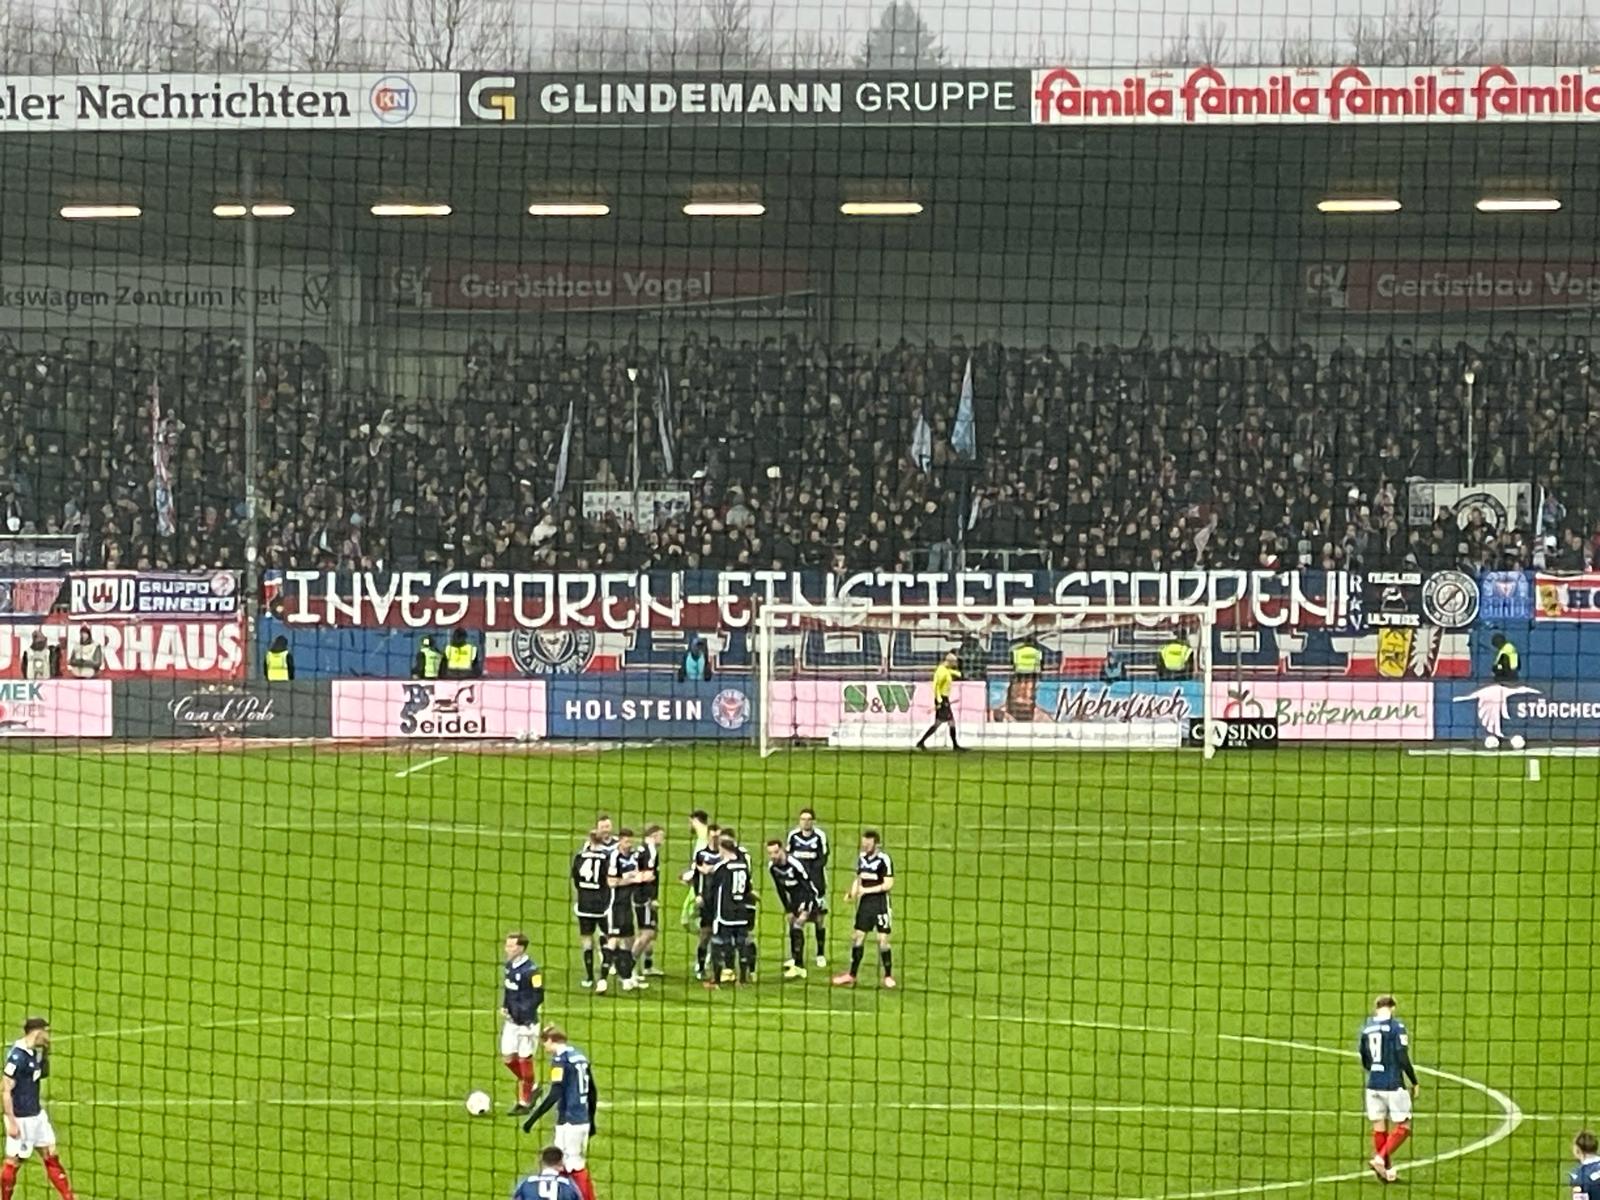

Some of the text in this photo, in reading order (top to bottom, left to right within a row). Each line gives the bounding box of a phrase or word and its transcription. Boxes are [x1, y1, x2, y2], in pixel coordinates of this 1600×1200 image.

[0, 81, 352, 121] ler Nachrichten
[379, 88, 410, 112] KN
[539, 81, 1017, 114] GLINDEMANN GRUPPE
[1034, 67, 1174, 122] famila
[1180, 66, 1320, 121] famila
[1324, 65, 1465, 121] famila
[115, 286, 223, 307] Zentrum
[230, 285, 283, 307] Kel
[460, 272, 612, 299] Gerüstbau
[622, 270, 713, 301] Vogel
[1376, 271, 1533, 298] Gerüstbau
[138, 580, 210, 594] GRUPPO
[286, 570, 1348, 630] INVESTOREN-EINSTIEG STOPPEN!
[138, 596, 235, 612] ERNESTO
[400, 711, 486, 734] Seidel
[565, 700, 702, 721] HOLSTEIN
[1275, 697, 1424, 727] Brötzmann
[578, 857, 601, 883] 41
[731, 869, 748, 895] 18
